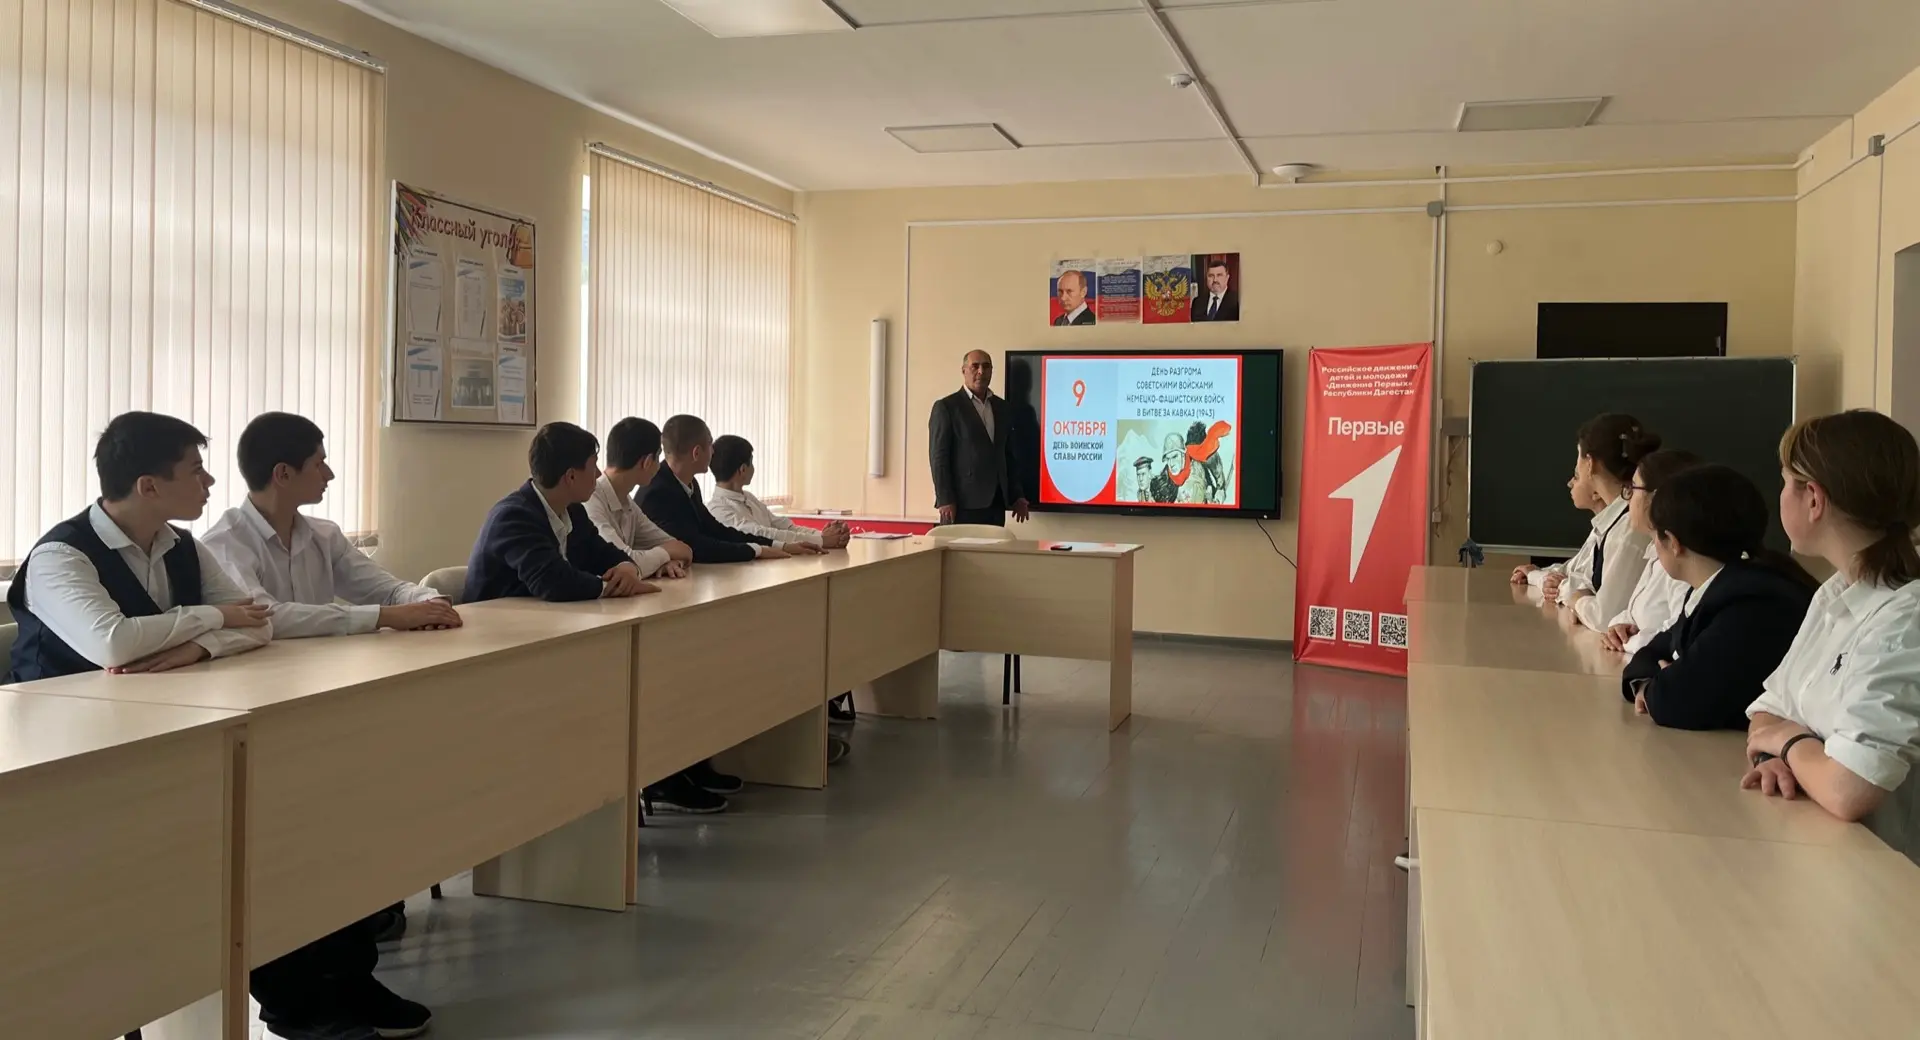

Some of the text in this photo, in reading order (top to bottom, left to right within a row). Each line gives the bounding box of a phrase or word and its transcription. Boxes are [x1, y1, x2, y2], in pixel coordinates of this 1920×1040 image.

[1150, 367, 1202, 377] ДЕНЬ РАЗГРОМА
[1373, 364, 1418, 372] движение
[1136, 378, 1214, 390] СОВЕТСКИМИ ВОЙСКАМИ
[1072, 380, 1086, 407] 9
[1126, 393, 1225, 404] НЕМЕЦКО-ФАШИСТСКИХ ВОЙСК
[1136, 408, 1215, 419] В БИТВЕ ЗА КАВКАЗ (1943)
[1053, 420, 1107, 436] ОКТЯБРЯ
[1328, 416, 1405, 441] Первые
[1052, 440, 1104, 450] ДЕНЬ ВОИНСКОЙ
[1053, 452, 1103, 461] СЛАВЫ РОССИИ
